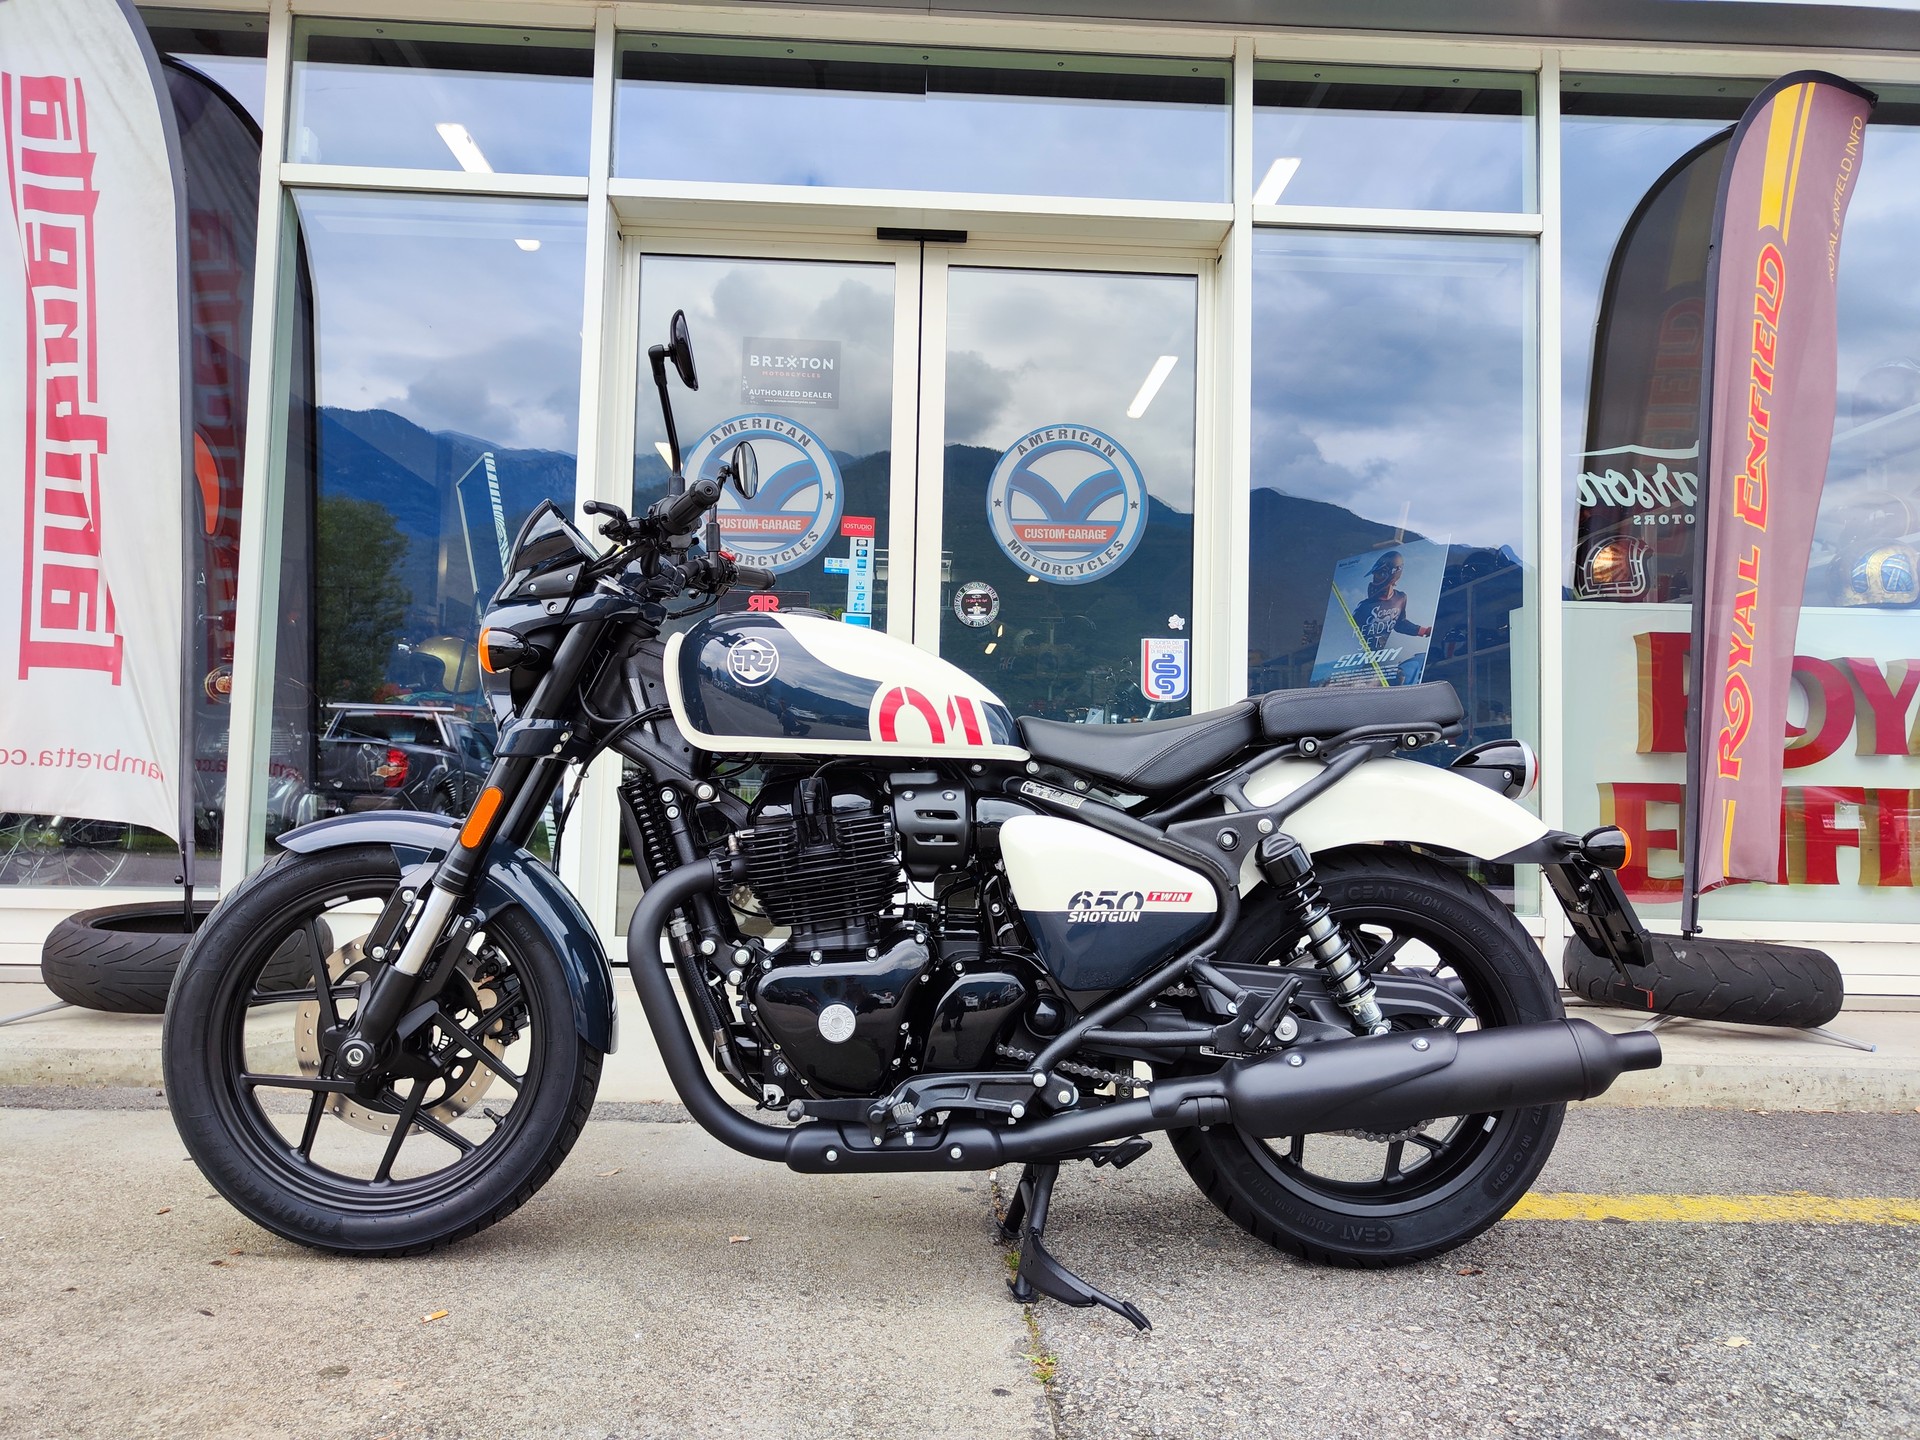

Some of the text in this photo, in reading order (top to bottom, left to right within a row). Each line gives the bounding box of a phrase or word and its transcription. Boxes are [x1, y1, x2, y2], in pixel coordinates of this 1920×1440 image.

[750, 354, 834, 370] BRIXTON
[762, 370, 821, 379] MOTORCYCLES
[749, 388, 833, 399] AUTHORIZED DEALER
[709, 417, 812, 448] AMERICAN
[1016, 428, 1116, 458] AMERICAN
[1718, 242, 1786, 780] ROYAL ENFIELD
[717, 518, 802, 531] CUSTOM-GARAGE
[1024, 527, 1107, 540] CUSTOM-GARAGE
[1007, 538, 1126, 577] MOTORCYCLES
[1067, 890, 1190, 910] 650 TWIN
[1067, 911, 1141, 923] SHOTGUN
